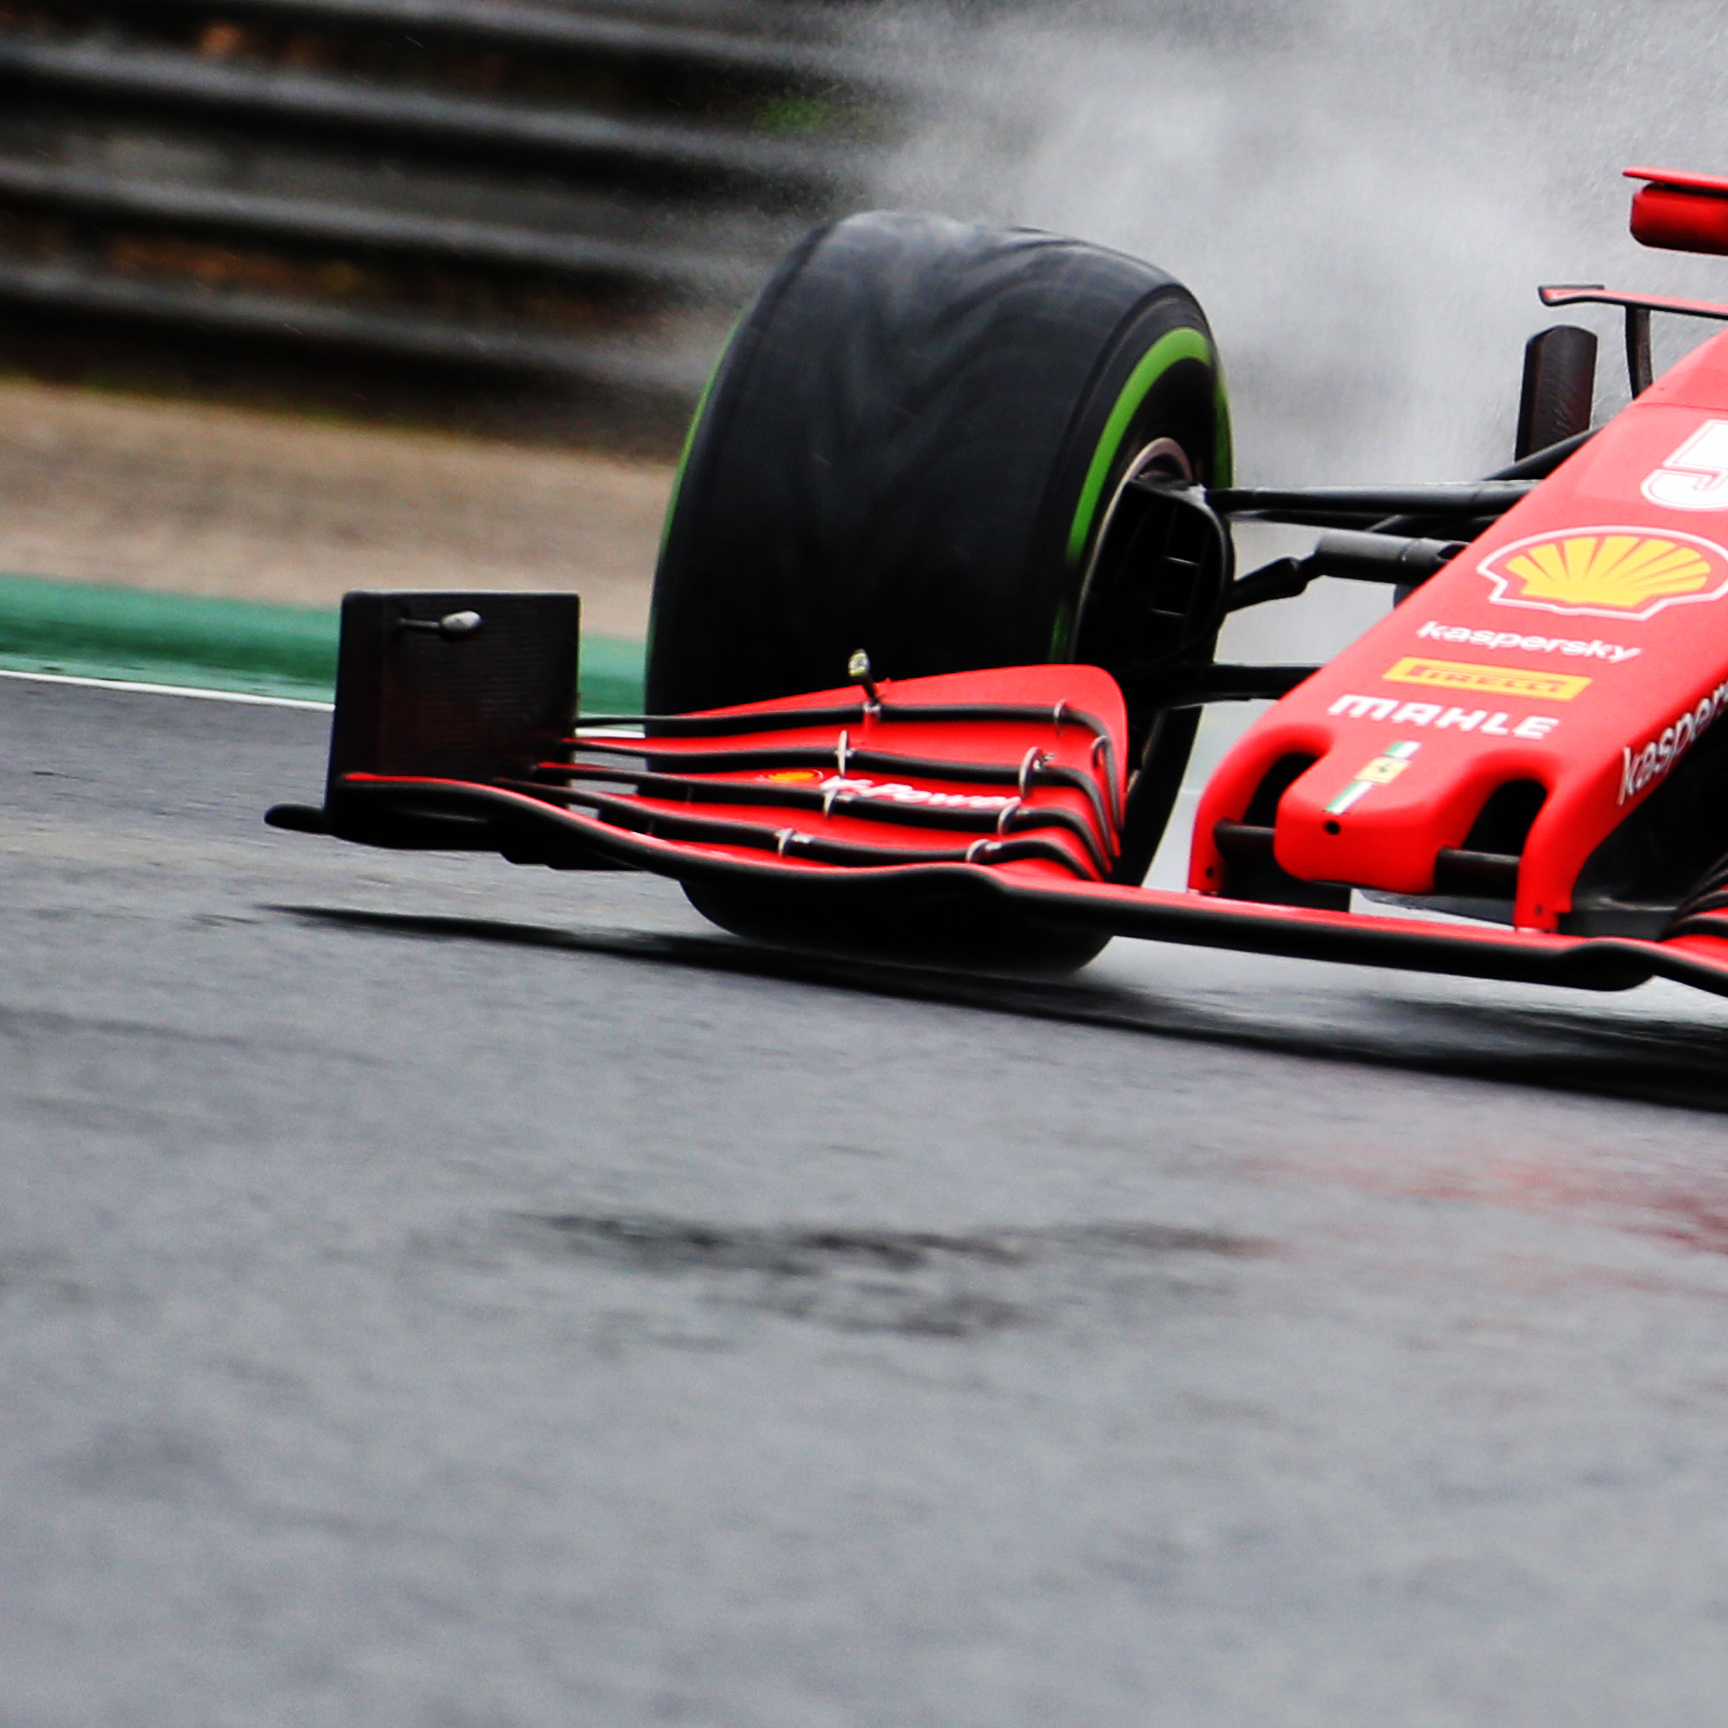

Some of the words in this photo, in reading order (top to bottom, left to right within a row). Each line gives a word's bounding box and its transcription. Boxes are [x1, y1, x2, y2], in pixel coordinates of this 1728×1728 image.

[1416, 620, 1642, 663] kaspersky
[1403, 663, 1569, 694] PIRELLI
[1327, 693, 1561, 740] MAHLE
